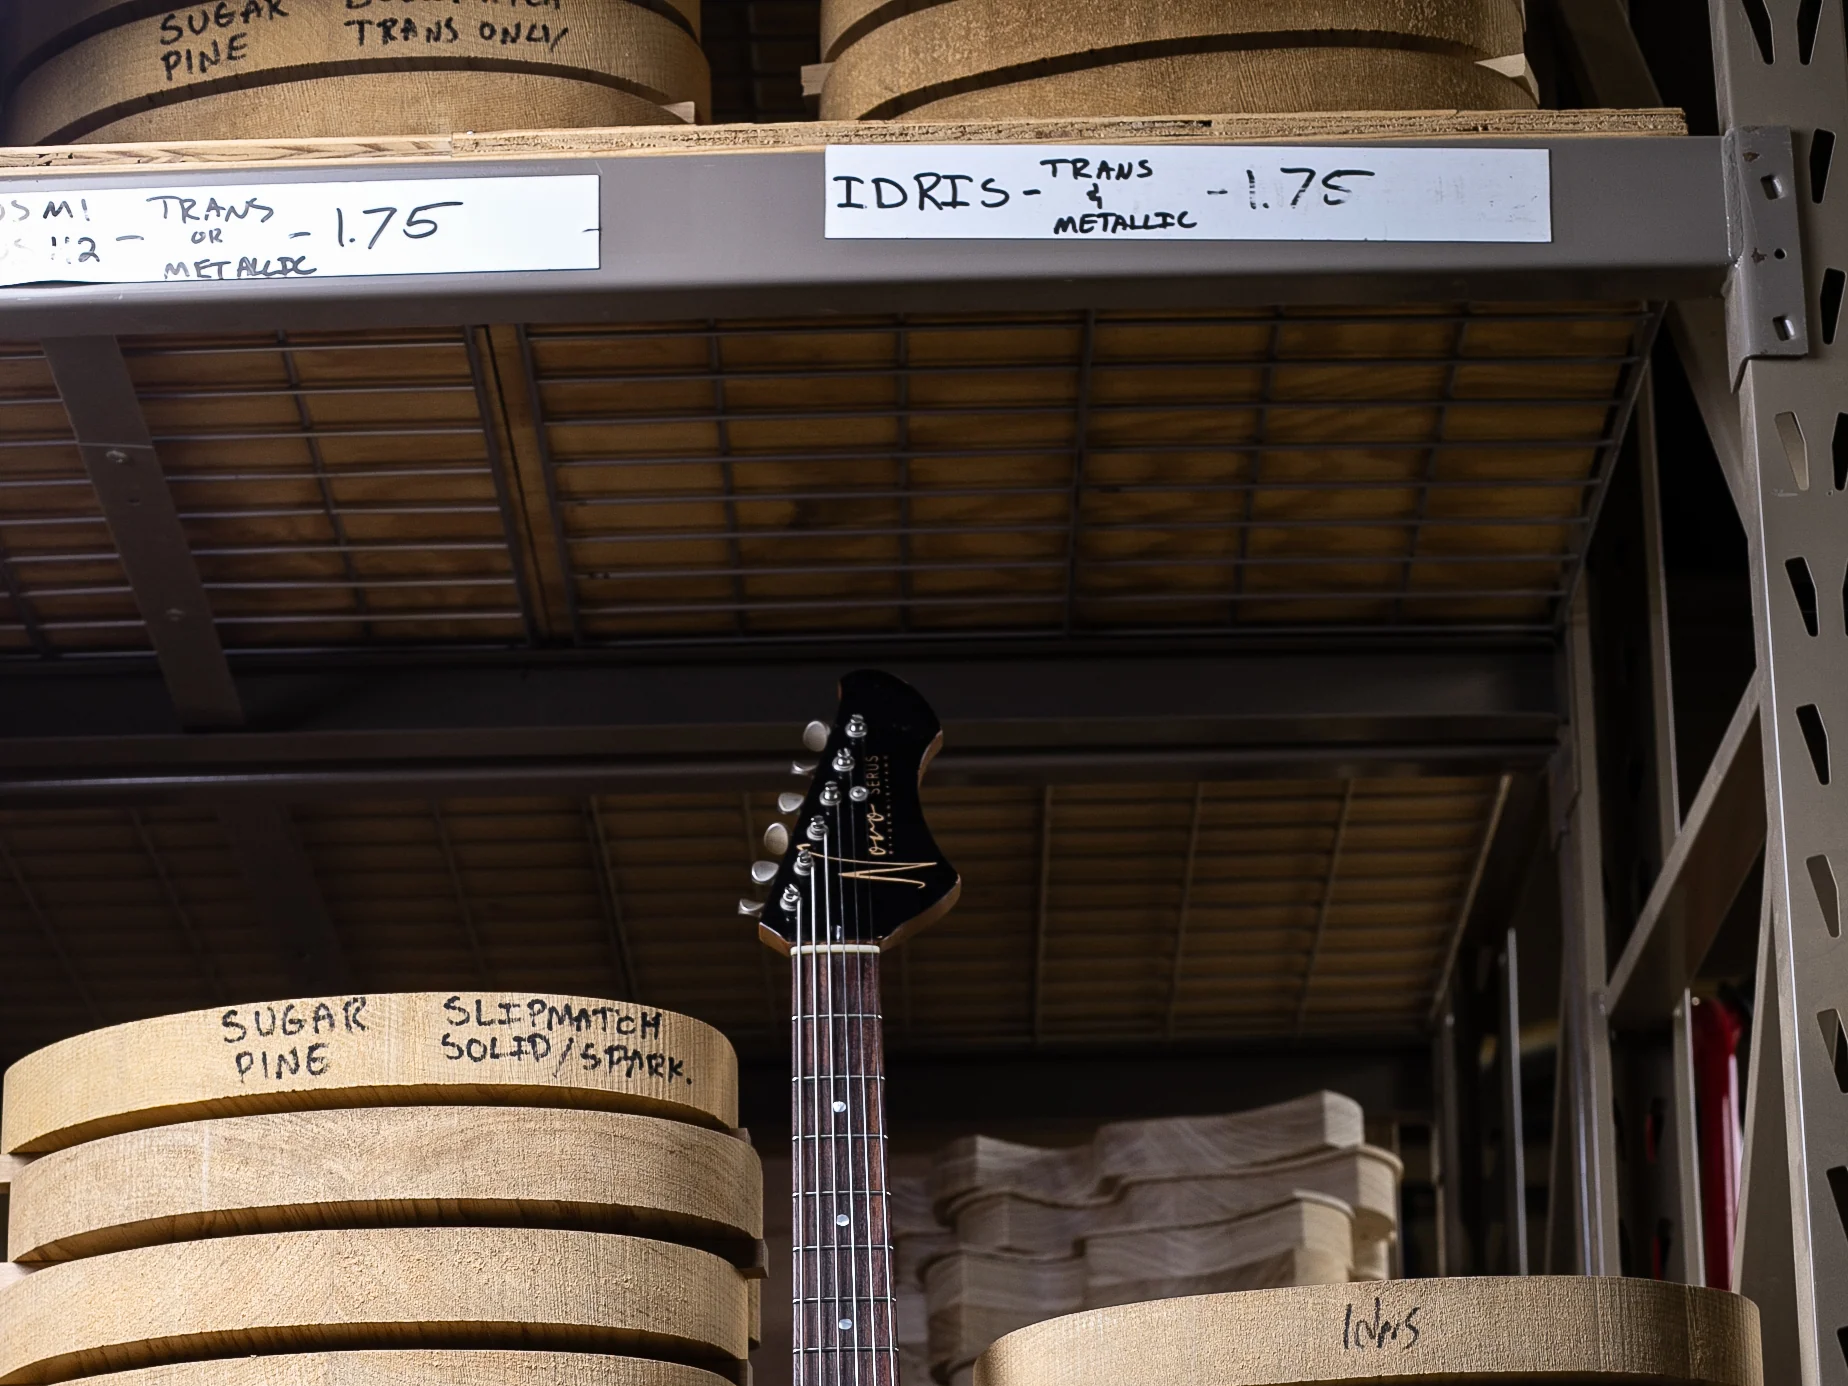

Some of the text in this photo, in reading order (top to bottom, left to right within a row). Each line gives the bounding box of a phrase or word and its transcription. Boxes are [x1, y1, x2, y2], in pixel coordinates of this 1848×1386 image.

[159, 0, 290, 46] SUGAR
[344, 17, 569, 53] TRANS ONLY
[160, 32, 249, 82] PINE
[1039, 157, 1154, 180] TRANS
[146, 195, 275, 224] TRANS
[1053, 211, 1198, 235] METALLIC
[191, 228, 223, 244] OR
[865, 755, 881, 795] SERUS
[221, 997, 370, 1044] SUGAR
[443, 995, 662, 1040] SLIPMATCH
[235, 1043, 331, 1083] PINE
